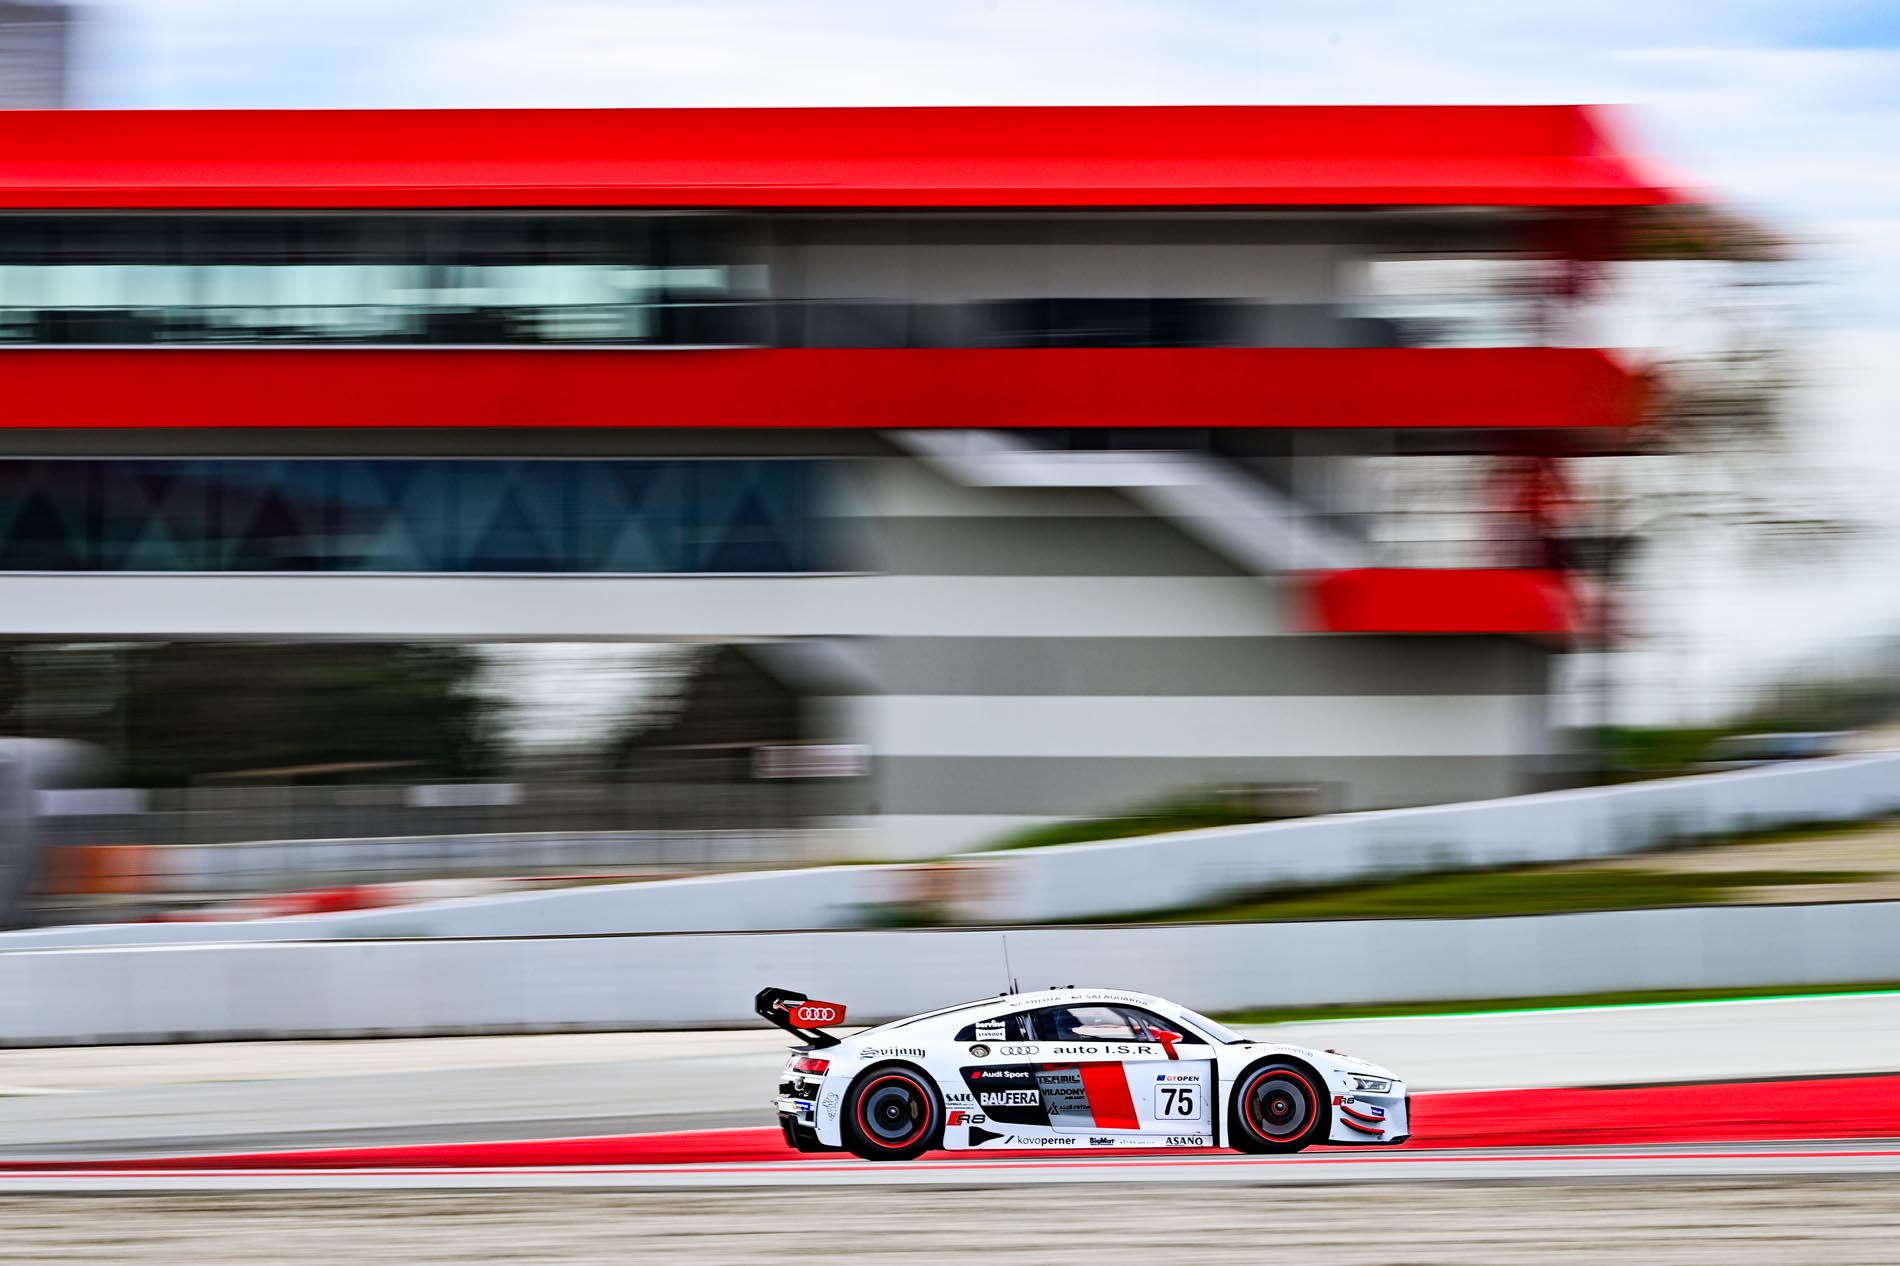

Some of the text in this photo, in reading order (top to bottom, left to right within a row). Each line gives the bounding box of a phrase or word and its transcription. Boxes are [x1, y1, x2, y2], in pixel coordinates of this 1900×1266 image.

[1053, 1045, 1158, 1055] auto I.S.R.
[1003, 1071, 1030, 1079] Sport
[980, 1091, 1038, 1105] BAUFERA
[1160, 1088, 1193, 1116] 75
[1017, 1135, 1076, 1147] kovoperner
[1165, 1136, 1204, 1146] ASANO
